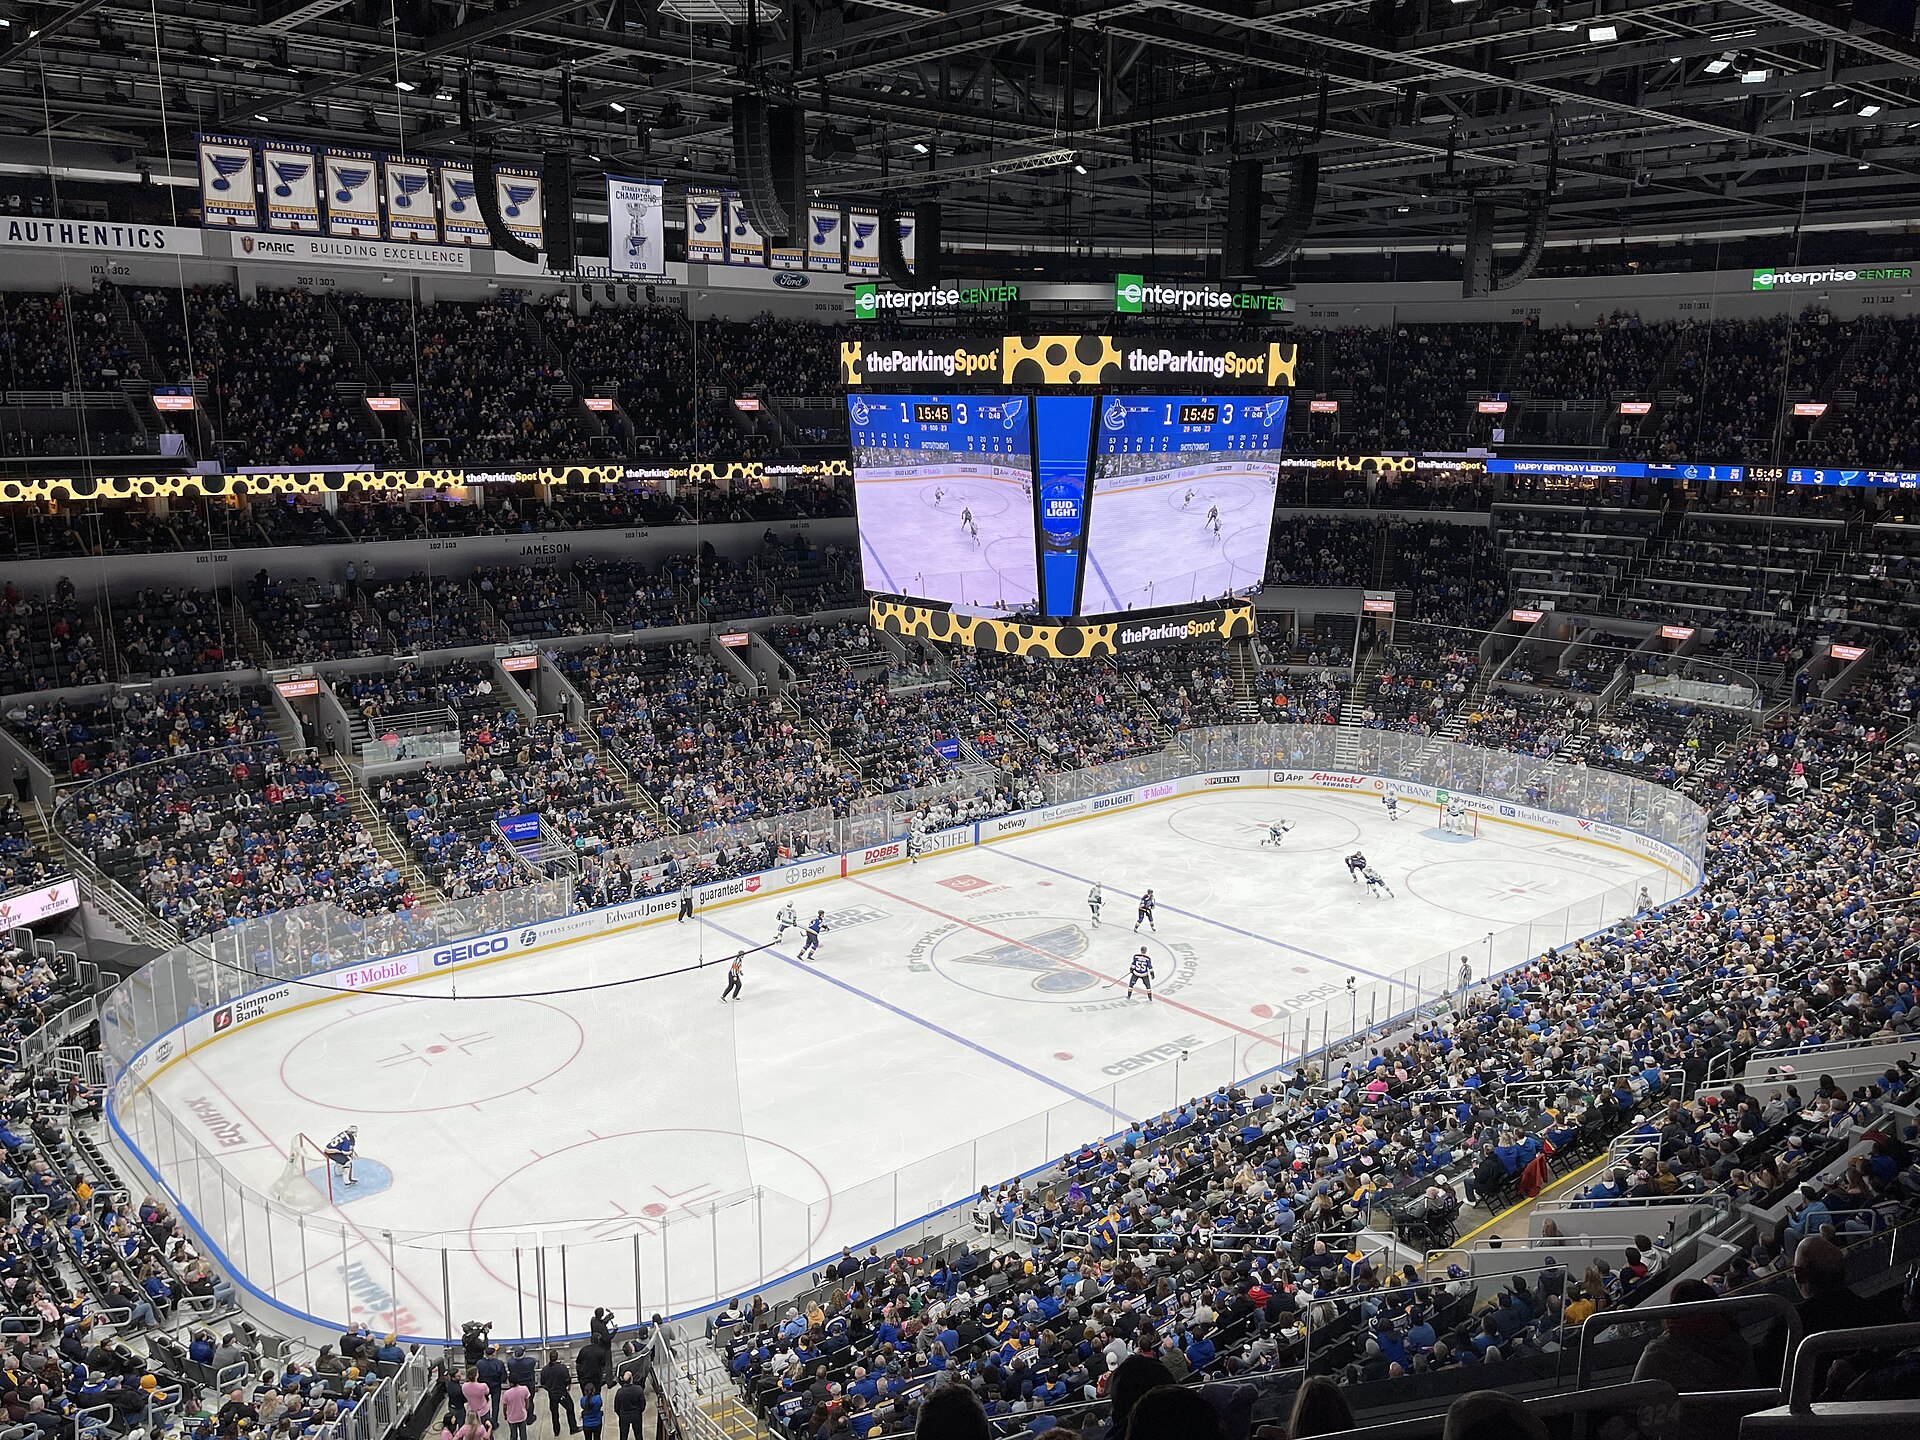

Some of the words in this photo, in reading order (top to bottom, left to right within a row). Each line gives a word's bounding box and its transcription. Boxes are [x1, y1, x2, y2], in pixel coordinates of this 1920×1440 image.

[621, 185, 642, 193] STANLEY
[615, 191, 657, 203] CHAMPIONS
[207, 207, 254, 216] CHAMPIONS
[332, 217, 377, 226] CHAMPIONS
[393, 222, 434, 230] CHAMPIONS
[8, 220, 166, 249] AUTHENTICS
[447, 226, 488, 234] CHAMPIONS
[258, 241, 295, 253] PARIC
[310, 242, 377, 257] BUILDING
[384, 247, 464, 263] EXCELLENCE
[690, 245, 722, 253] CHAMPIONS
[629, 261, 647, 270] 2019
[780, 273, 803, 286] Ford
[1754, 268, 1857, 286] enterprise
[1857, 268, 1912, 280] CENTER
[857, 285, 960, 312] enterprise
[960, 286, 1018, 304] CENTER
[1118, 284, 1233, 310] enterprise
[1232, 293, 1285, 311] CENTER
[865, 348, 999, 374] theParkingSpot
[1127, 350, 1265, 375] theParkingSpot
[900, 402, 910, 423] 1
[917, 406, 949, 420] 15:45
[956, 403, 968, 425] 3
[1163, 403, 1173, 425] 1
[1183, 407, 1215, 421] 15:45
[1222, 403, 1234, 424] 3
[904, 440, 909, 448] 2
[1109, 445, 1114, 453] 0
[1136, 444, 1141, 452] 0
[1514, 463, 1541, 471] HAPPY
[1542, 464, 1585, 473] BIRTHDAY
[1586, 464, 1616, 473] LEDDY!
[1708, 466, 1716, 480] 1
[1748, 467, 1783, 478] 15:45
[1155, 473, 1171, 481] LIGHT
[1791, 474, 1802, 482] 23
[1813, 470, 1824, 484] 3
[1901, 473, 1916, 481] CAR
[1900, 481, 1916, 489] WSH
[1051, 500, 1073, 509] BUD
[1046, 508, 1077, 518] LIGHT
[519, 543, 571, 556] JAMESON
[534, 556, 557, 565] CLUB
[1120, 618, 1217, 645] theParkingSpot
[1210, 776, 1240, 785] PURINA
[1308, 772, 1367, 784] Schnucks
[1322, 781, 1353, 789] REWARDS
[1150, 785, 1173, 798] Mobile
[1385, 782, 1407, 793] PNC
[1406, 786, 1432, 798] BANK
[1093, 799, 1110, 810] BUD
[1110, 793, 1133, 807] LIGHT
[1042, 809, 1055, 820] First
[1055, 802, 1087, 816] Community
[1501, 806, 1515, 816] BJC
[1517, 810, 1560, 826] HealthCare
[514, 825, 538, 833] Technology
[998, 818, 1027, 831] betway
[1594, 822, 1609, 832] World
[1609, 827, 1622, 835] Wide
[933, 830, 970, 850] STIFEL
[1594, 828, 1622, 840] Technology
[865, 844, 899, 861] DOBBS
[1634, 835, 1659, 852] WELLS
[1659, 844, 1680, 861] FARGO
[1546, 846, 1632, 868] betway
[801, 866, 826, 879] Bayer
[699, 879, 744, 905] guaranteed
[745, 878, 761, 888] Rate
[963, 884, 1012, 899] TOYOTA
[40, 898, 69, 912] VICTORY
[788, 911, 792, 919] 2
[828, 910, 883, 931] IGHT
[966, 910, 1039, 923] CENTER
[538, 926, 566, 938] EXPRESS
[567, 921, 592, 931] SCRIPTS
[432, 936, 509, 968] GEICO
[360, 962, 408, 985] Mobile
[1135, 961, 1148, 972] 55
[236, 988, 290, 1013] Simmons
[1284, 982, 1347, 1010] pepsi
[236, 1006, 266, 1024] Bank
[1101, 1034, 1204, 1076] CENTENE
[184, 1096, 249, 1148] EQUIFAX
